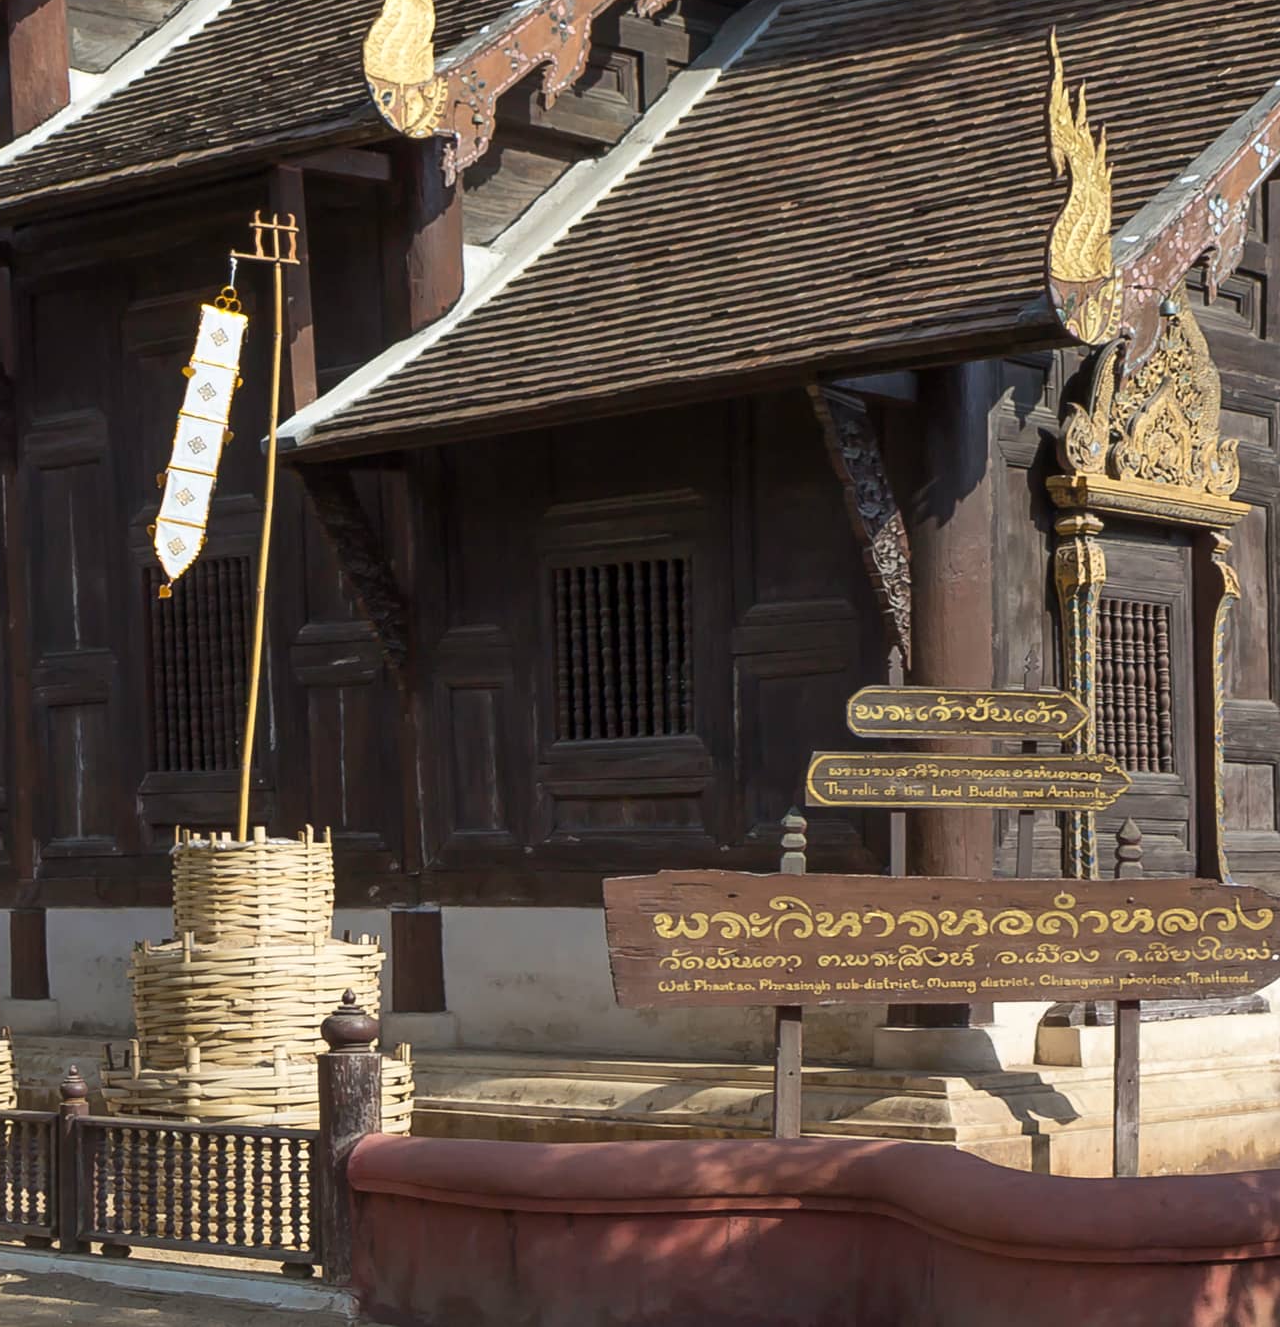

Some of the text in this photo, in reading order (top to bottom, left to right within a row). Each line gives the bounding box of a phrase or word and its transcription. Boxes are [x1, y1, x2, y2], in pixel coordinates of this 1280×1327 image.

[824, 782, 849, 795] The
[852, 783, 879, 796] relic
[884, 786, 897, 796] of
[904, 784, 925, 796] the
[932, 785, 962, 797] Lord
[968, 786, 1018, 798] Buddha
[1023, 788, 1044, 798] and
[653, 895, 1274, 942] พระวิหารหอคำหลวง
[658, 980, 690, 992] Wat
[759, 979, 831, 995] Phrasingh
[927, 978, 976, 993] Muang
[1040, 974, 1114, 989] Chiangmai
